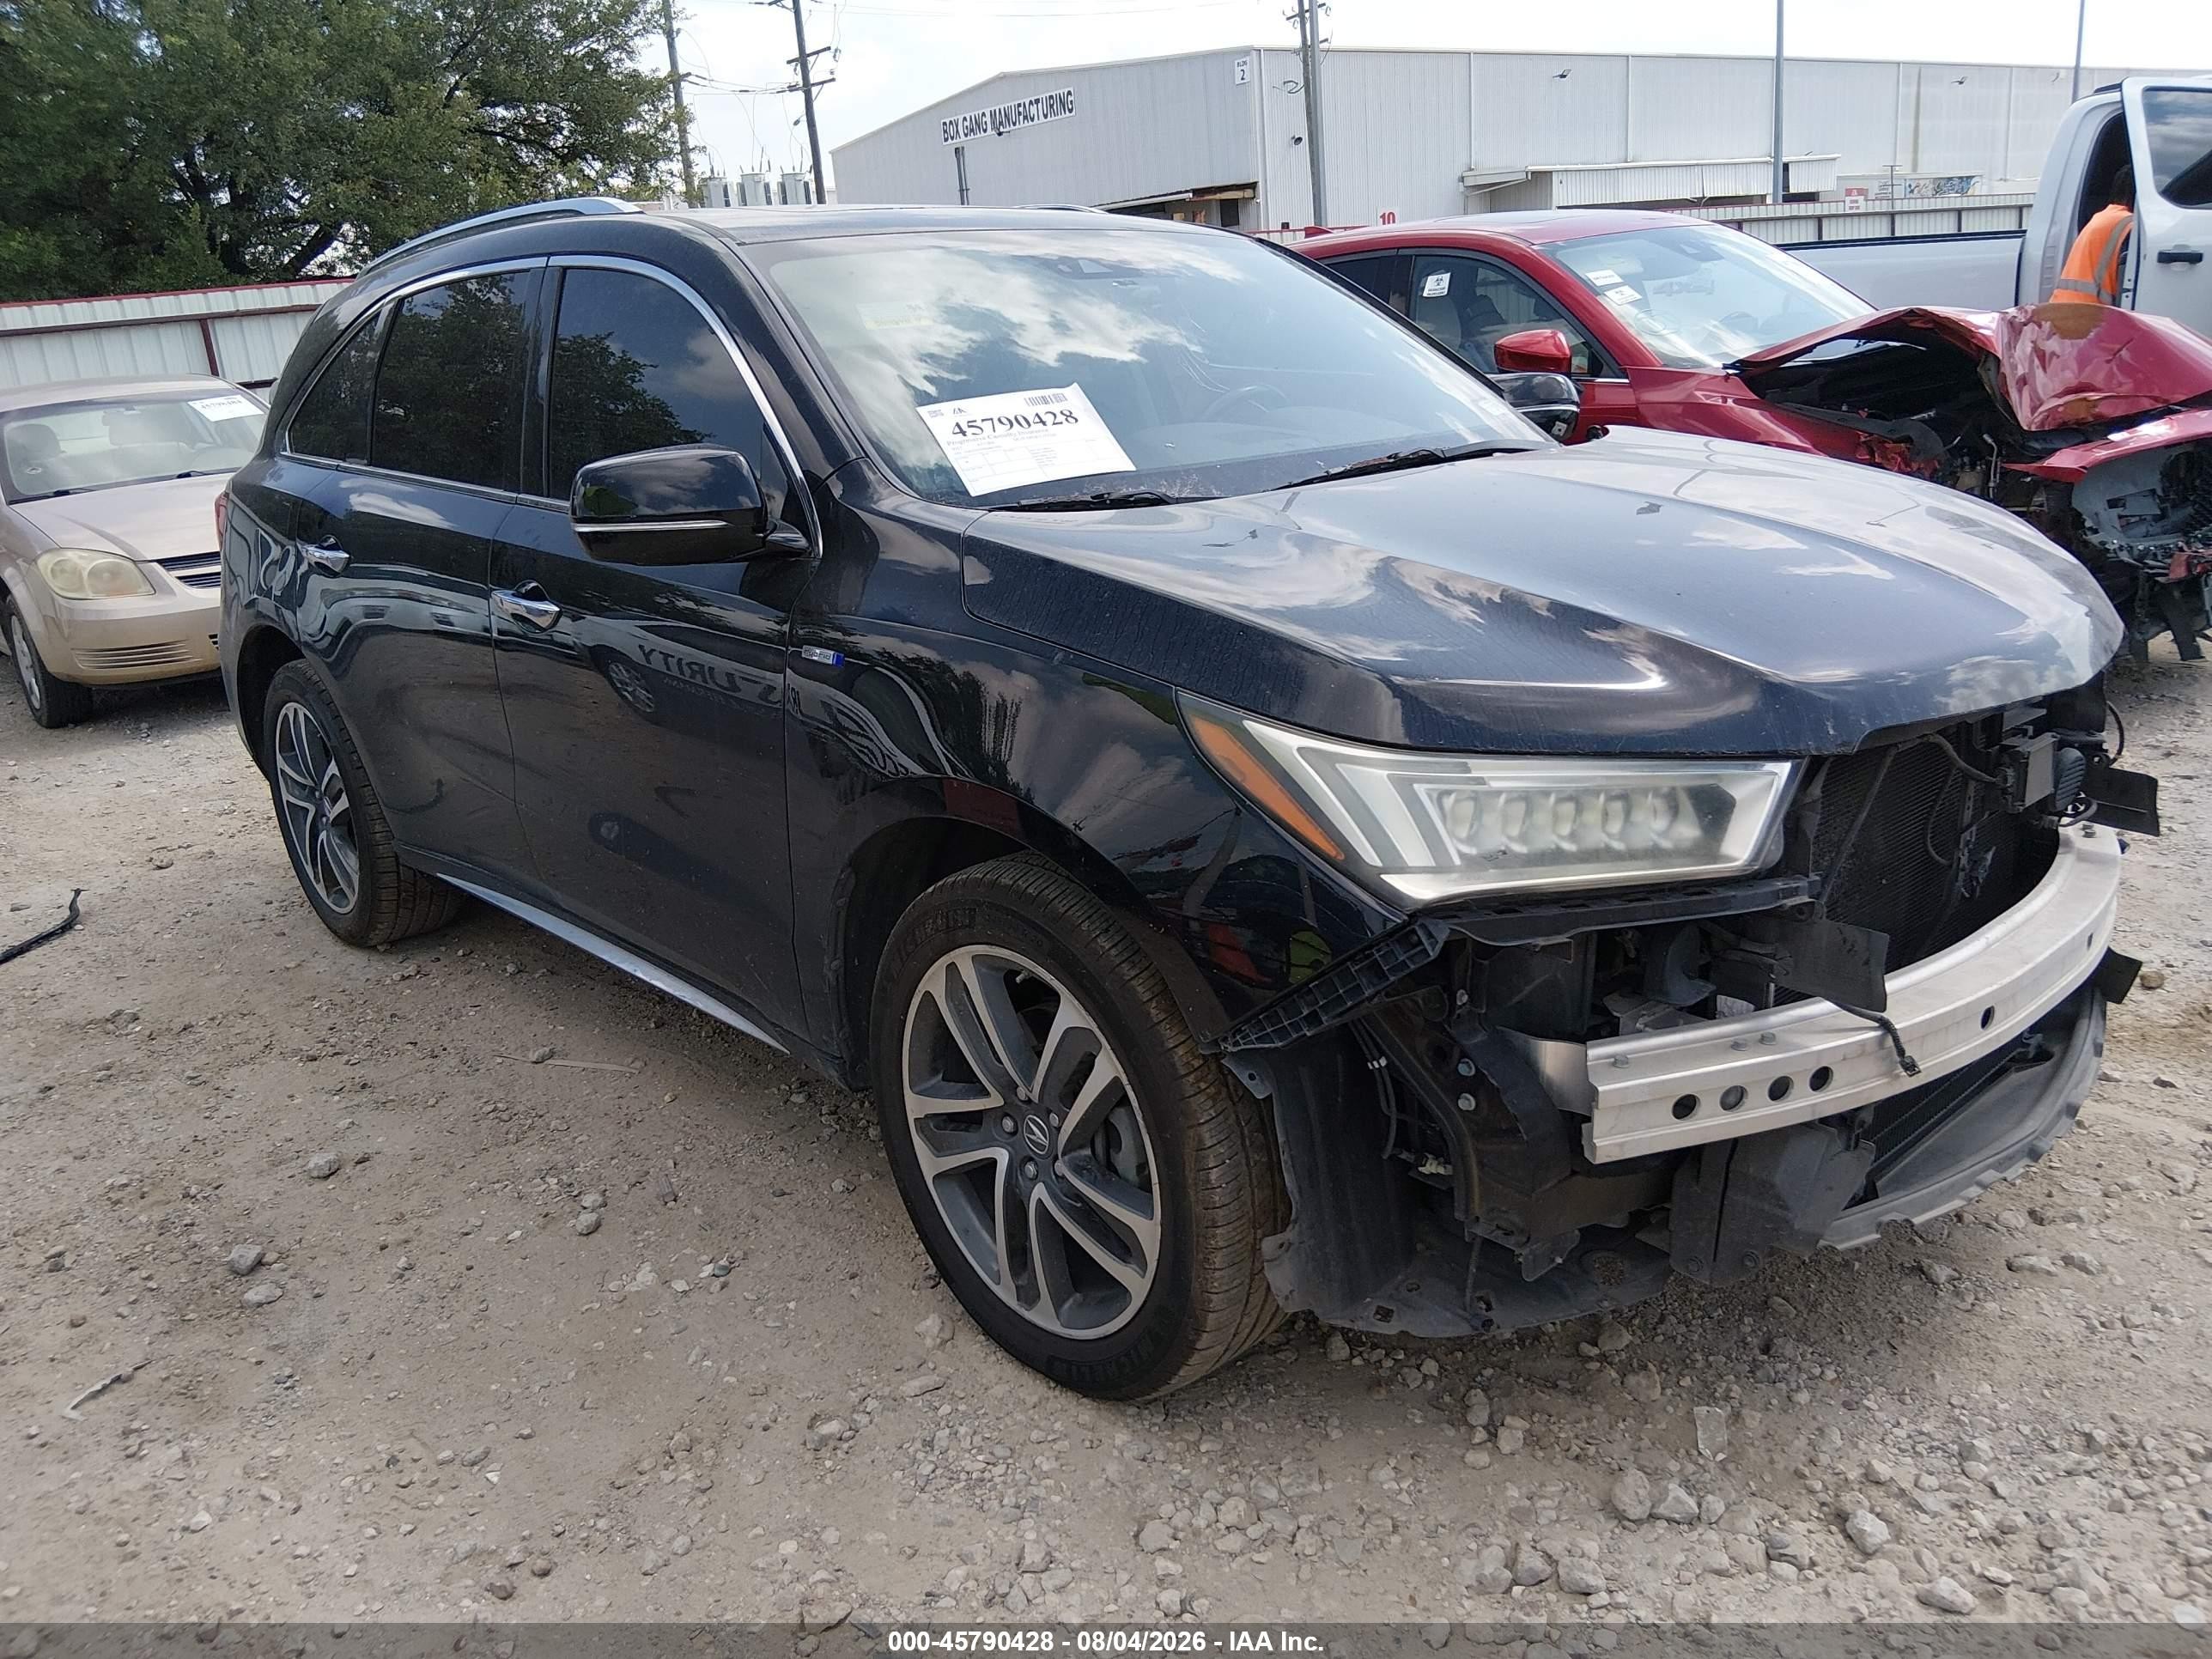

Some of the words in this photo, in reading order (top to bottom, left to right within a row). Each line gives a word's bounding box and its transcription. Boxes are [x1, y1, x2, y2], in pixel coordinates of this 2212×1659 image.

[1240, 69, 1246, 81] 2
[942, 118, 961, 143] BOX
[962, 112, 988, 138] GANG
[989, 90, 1073, 131] MANUFACTURING
[1379, 211, 1396, 225] 10
[951, 409, 1079, 437] 45790428
